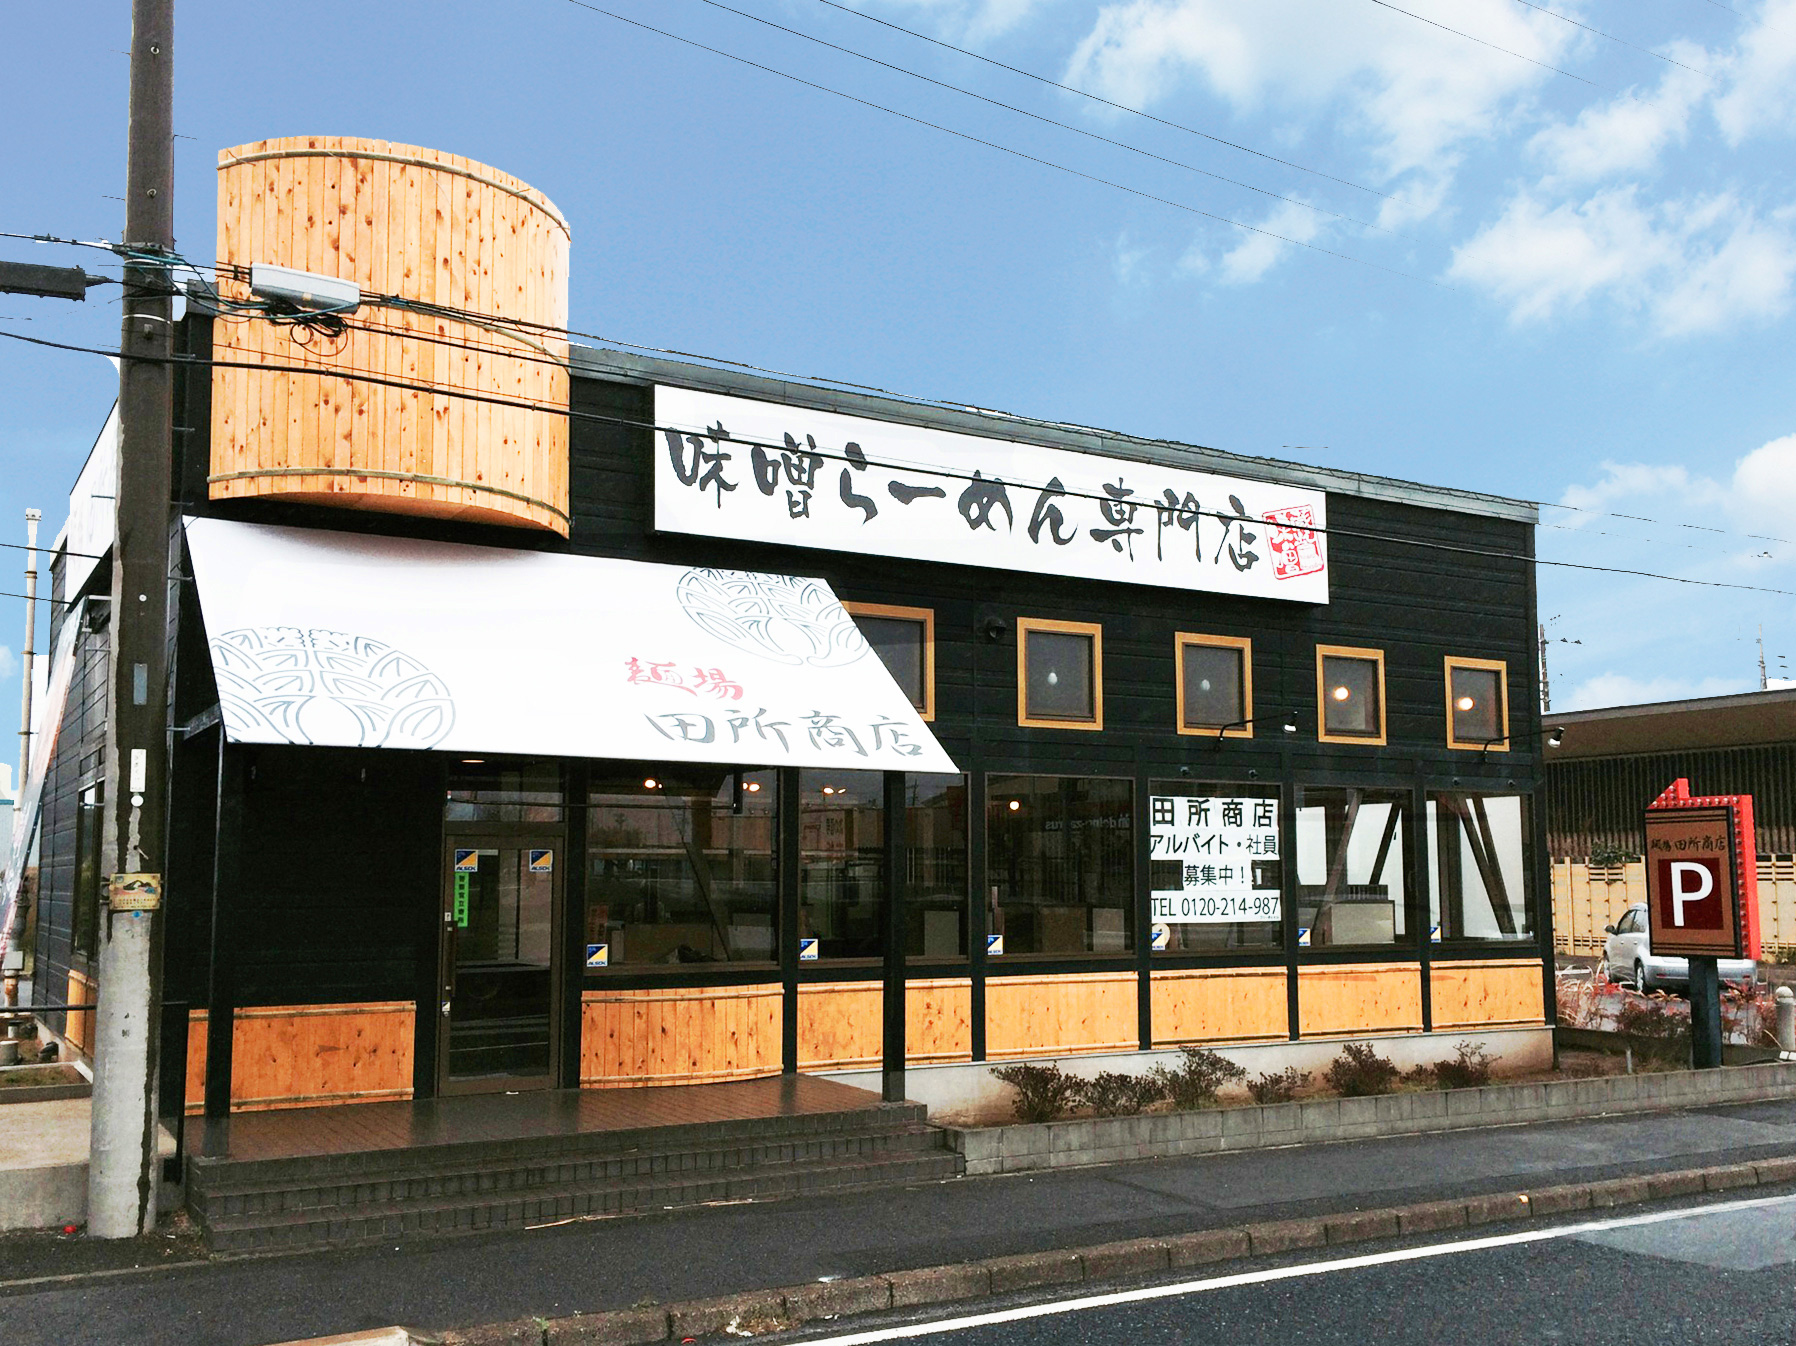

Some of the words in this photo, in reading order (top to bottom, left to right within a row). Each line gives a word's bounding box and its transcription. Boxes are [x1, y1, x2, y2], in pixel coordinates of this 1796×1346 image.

[665, 420, 1260, 572] 味噌らーめん専門店
[643, 707, 924, 757] 田所商店
[1152, 797, 1274, 828] 田所商店
[1150, 832, 1278, 855] アルバイト・社員
[1183, 864, 1245, 886] 募集中！
[1150, 898, 1177, 917] TEL
[1181, 897, 1279, 917] 0120-214-987
[1670, 861, 1714, 927] P
